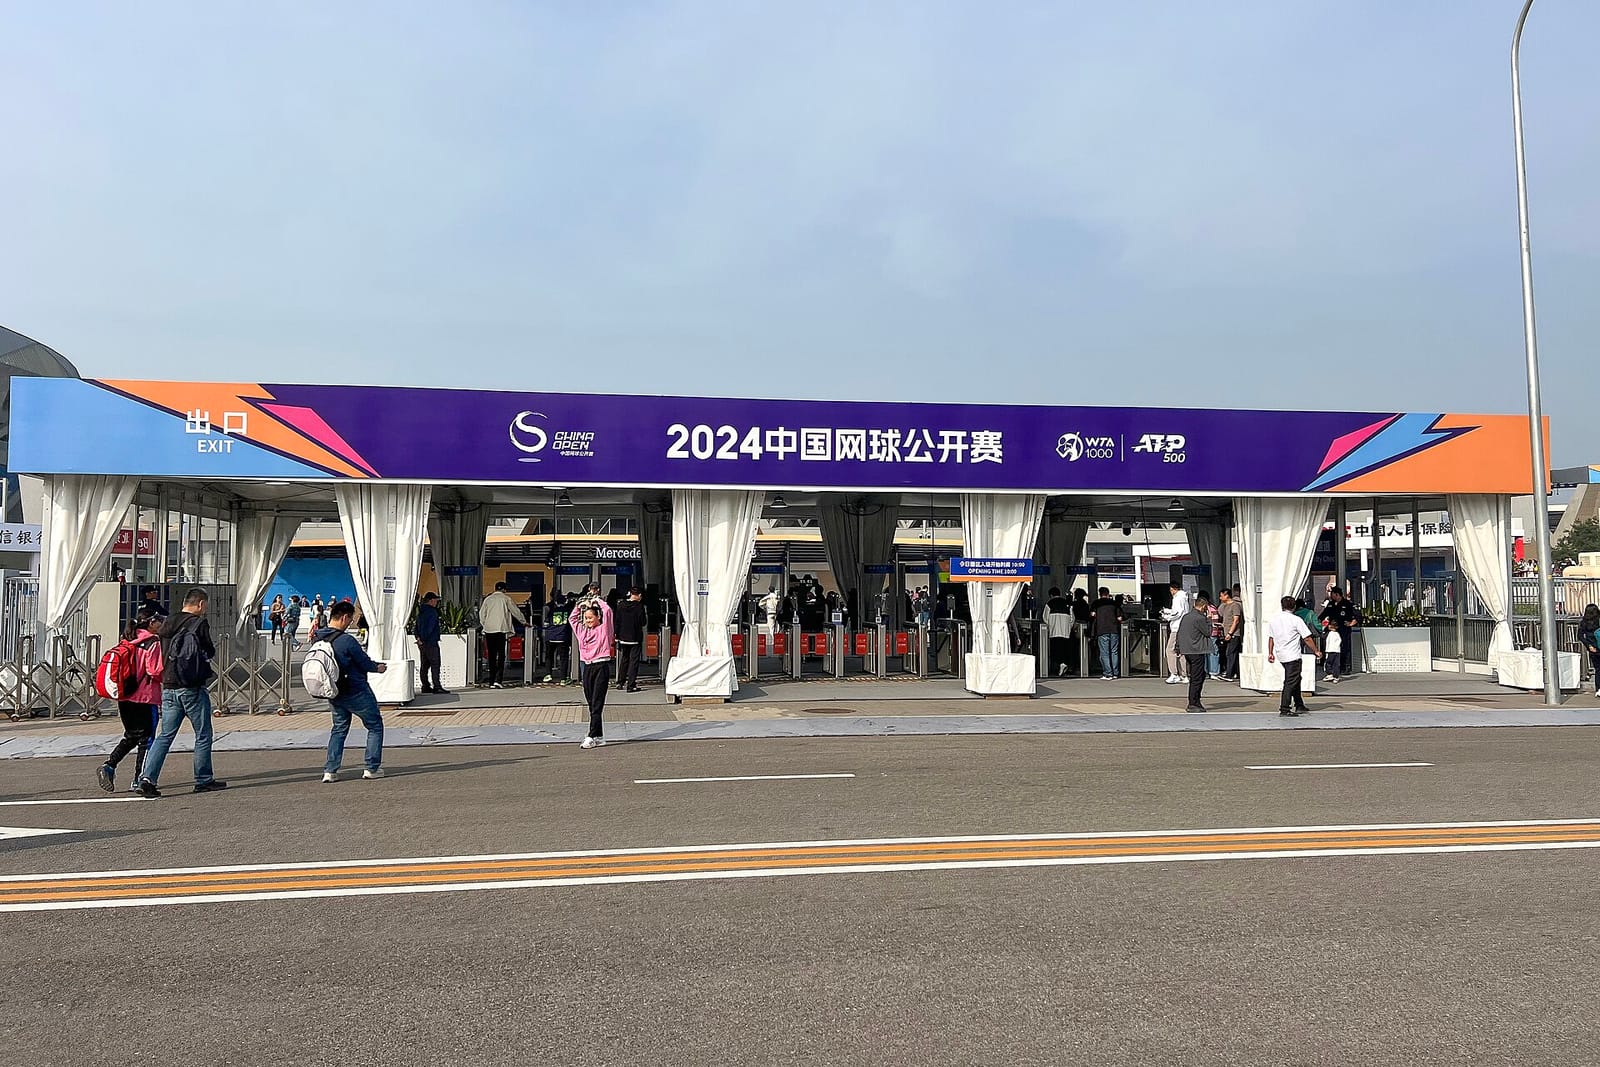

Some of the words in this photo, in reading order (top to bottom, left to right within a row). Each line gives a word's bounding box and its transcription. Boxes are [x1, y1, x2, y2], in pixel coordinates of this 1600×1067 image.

[185, 408, 248, 435] 出口
[554, 431, 595, 441] CHINA
[1085, 437, 1115, 447] WTA
[197, 439, 235, 453] EXIT
[552, 441, 590, 450] OPEN
[666, 423, 1004, 465] 2024中国网球公开赛
[1131, 434, 1186, 453] ATP
[1085, 448, 1113, 459] 1000
[1162, 452, 1186, 463] 500
[1355, 522, 1452, 537] 中国人民保险
